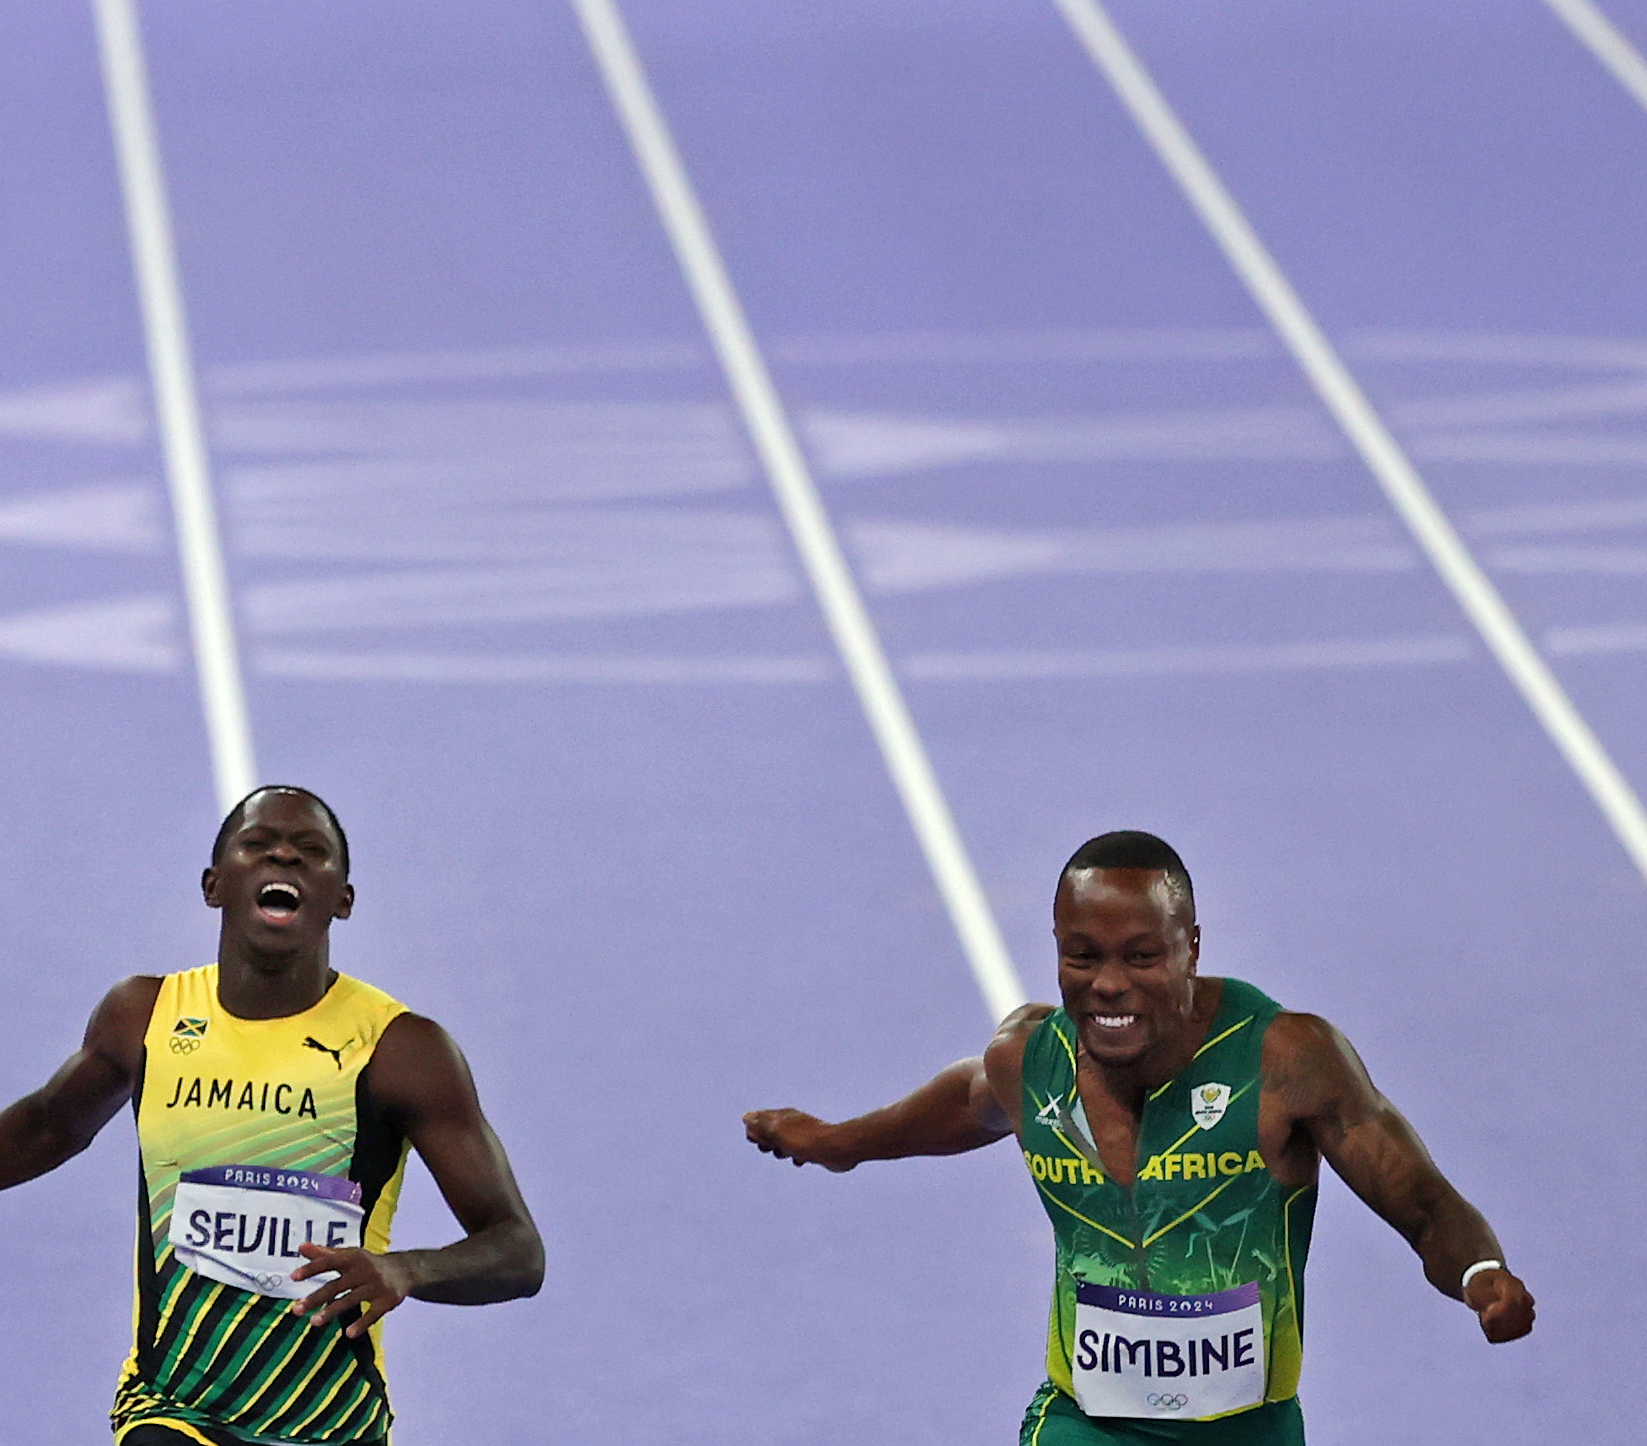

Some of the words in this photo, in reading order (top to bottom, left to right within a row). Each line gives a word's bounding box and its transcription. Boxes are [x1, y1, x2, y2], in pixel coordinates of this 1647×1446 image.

[166, 1077, 317, 1119] JAMAICA
[224, 1168, 270, 1186] PARIS
[276, 1174, 319, 1191] 2024
[1138, 1150, 1266, 1181] AFRICA
[1118, 1294, 1163, 1311] PARIS
[1169, 1300, 1214, 1312] 2024
[1076, 1327, 1255, 1377] SIMBINE
